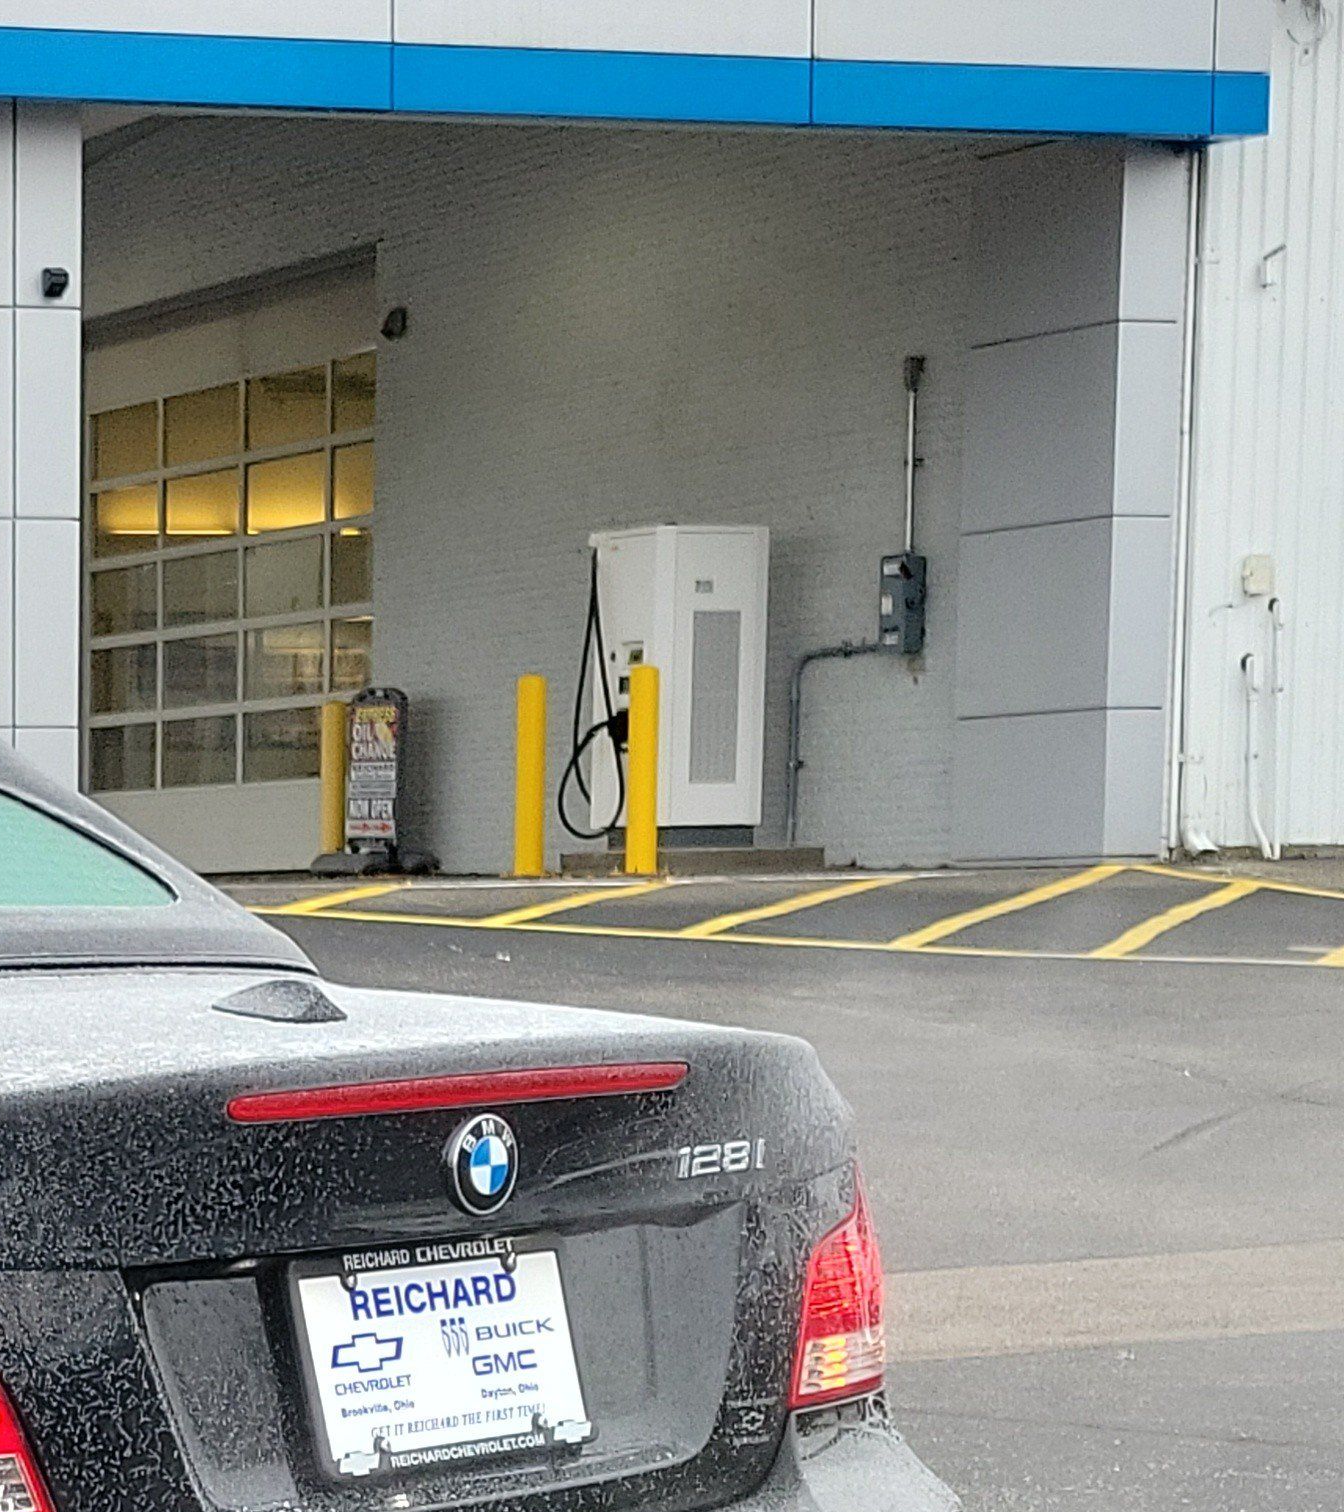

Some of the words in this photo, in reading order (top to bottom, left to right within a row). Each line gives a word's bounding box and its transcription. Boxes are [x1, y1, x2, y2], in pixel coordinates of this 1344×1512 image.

[352, 723, 374, 743] OIL
[462, 1119, 513, 1154] BMW
[343, 1249, 410, 1271] REICHARD
[415, 1237, 514, 1263] CHEVROLET
[349, 1273, 517, 1321] REICHARD
[475, 1317, 555, 1341] BUICK
[472, 1349, 538, 1376] GMC
[334, 1374, 411, 1396] CHEVROLET
[518, 1382, 539, 1393] Ohio
[393, 1399, 415, 1411] Ohio
[394, 1423, 404, 1436] IT
[407, 1415, 459, 1434] REICHARD
[462, 1411, 482, 1426] THE
[485, 1406, 514, 1423] FIRST
[390, 1433, 546, 1468] REICHARDCHEVROLET.COM
